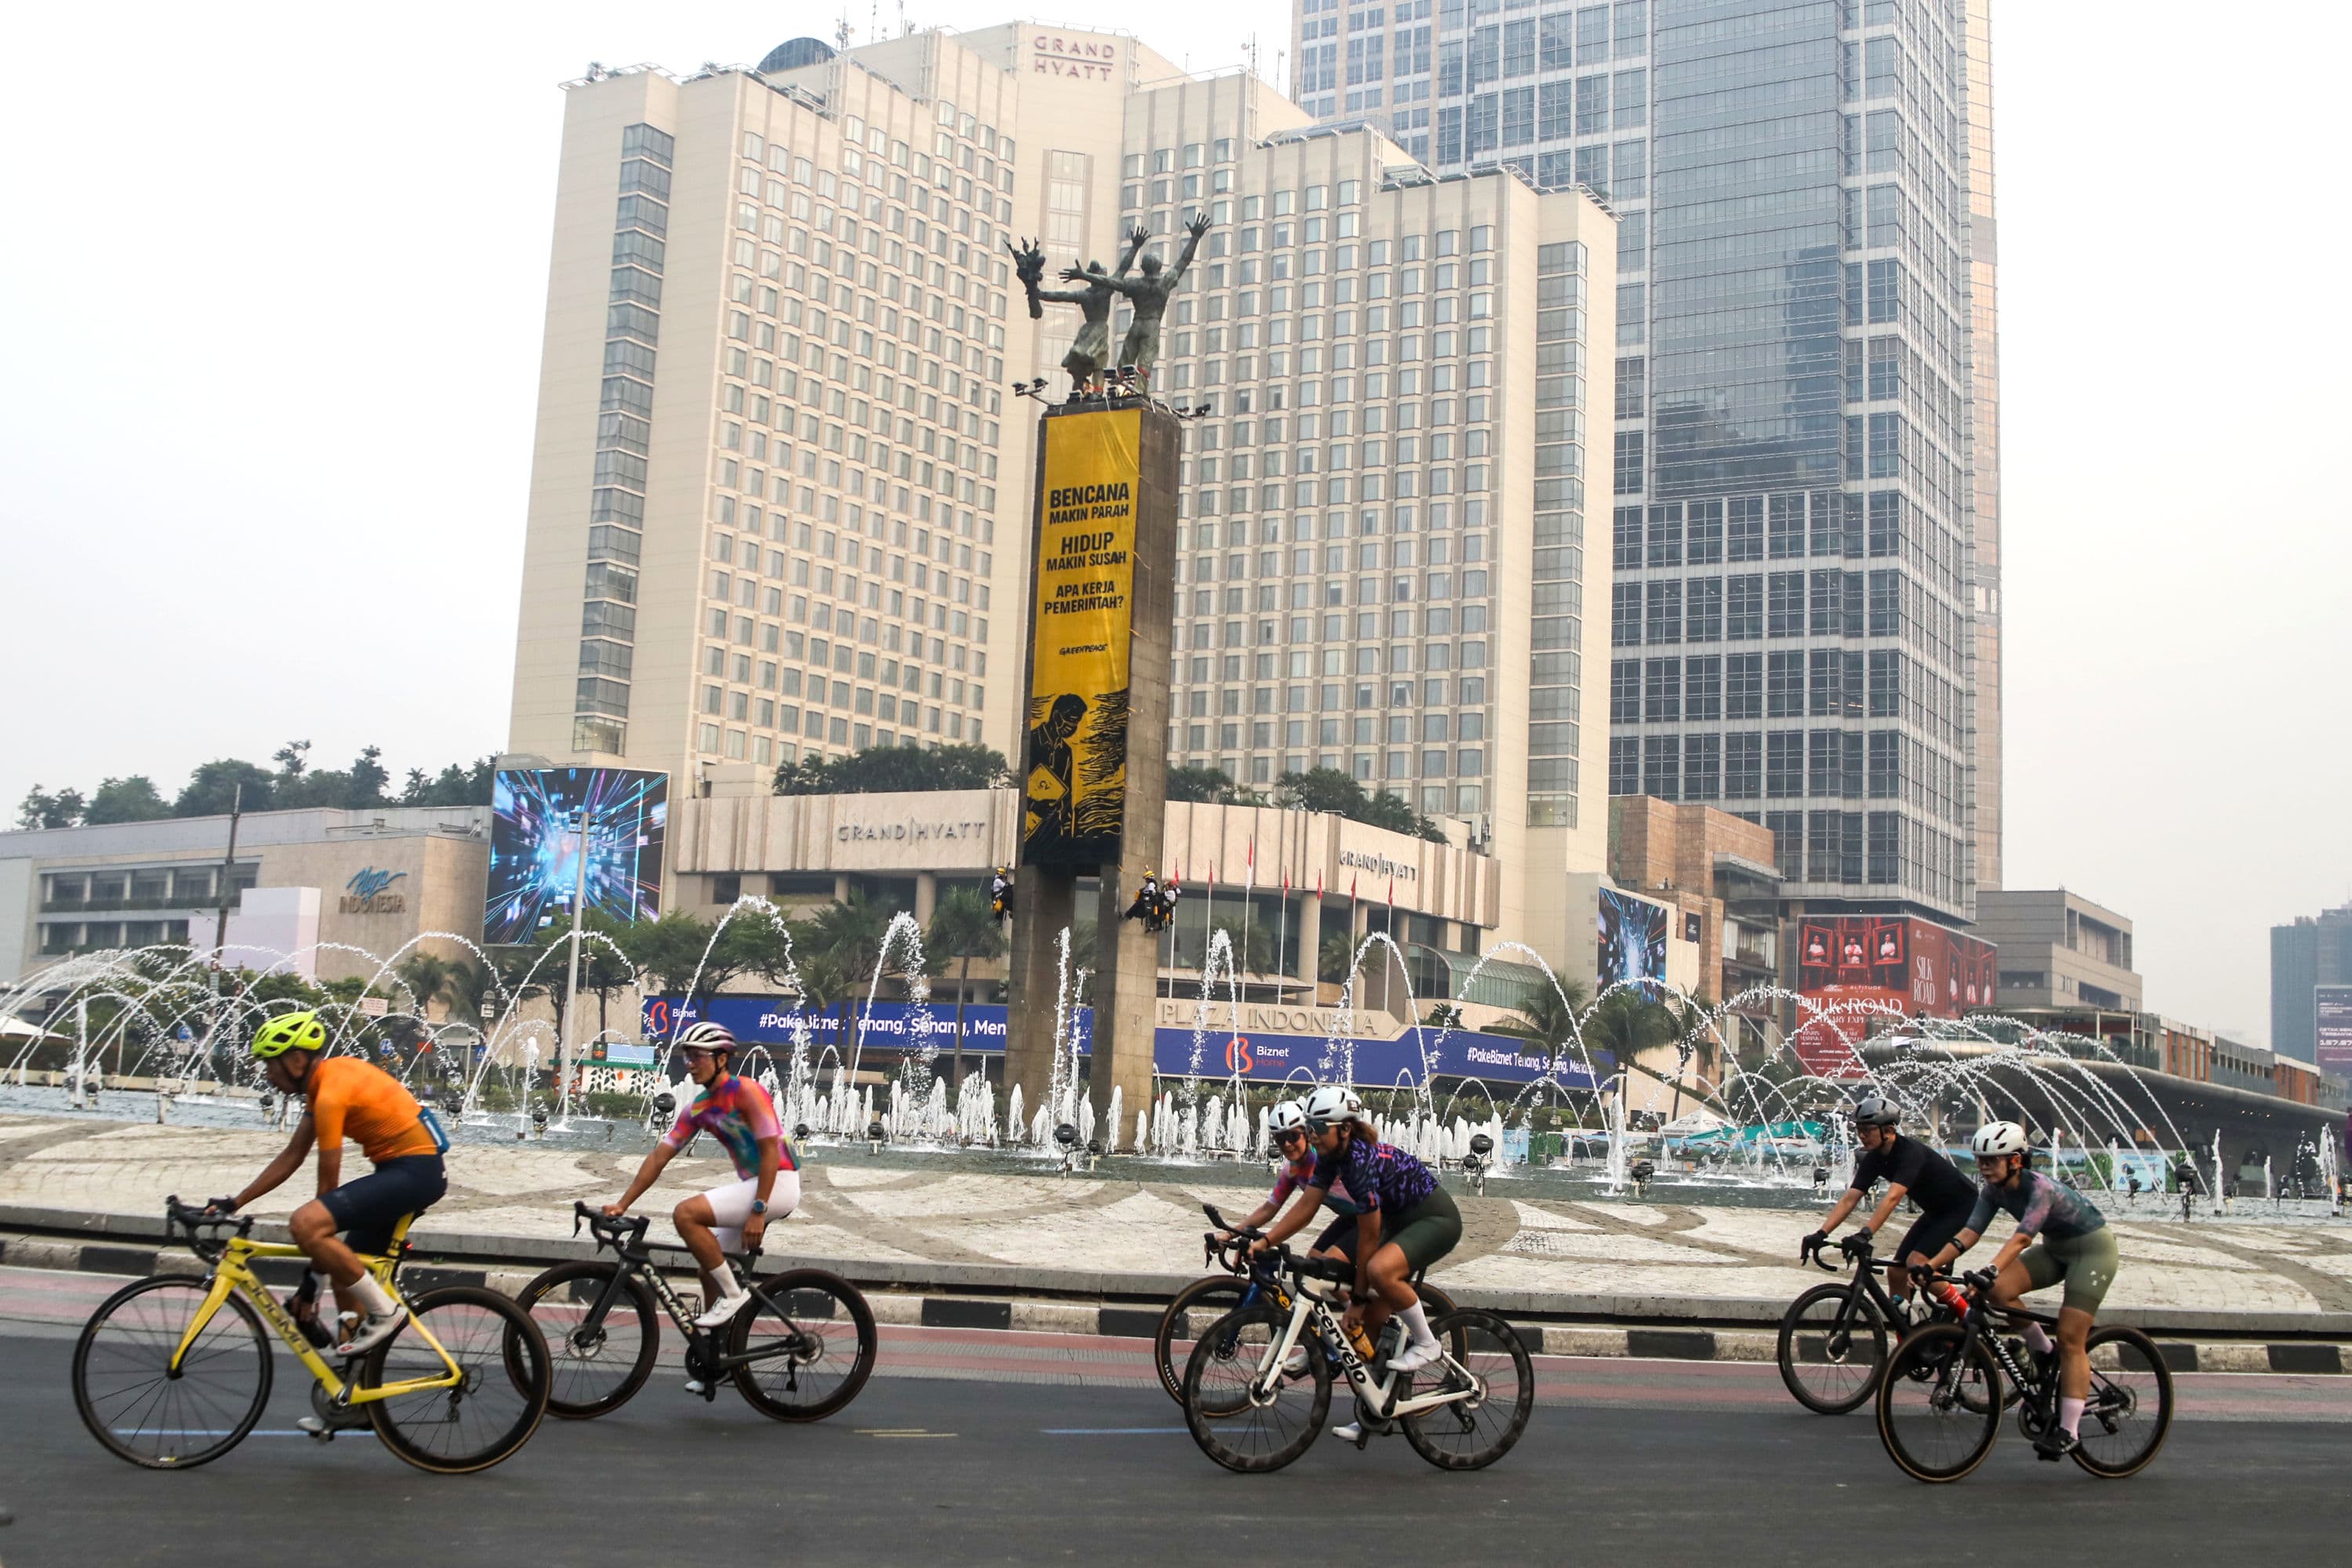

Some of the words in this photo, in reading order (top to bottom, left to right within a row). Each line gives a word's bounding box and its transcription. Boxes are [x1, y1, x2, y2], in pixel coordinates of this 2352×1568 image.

[1034, 36, 1115, 58] GRAND
[1034, 59, 1112, 82] HYATT
[1050, 482, 1129, 508] BENCANA
[1049, 508, 1088, 524] MAKIN
[1091, 504, 1129, 520] PARAH
[1061, 532, 1114, 555] HIDUP
[1047, 555, 1086, 572] MAKIN
[1089, 551, 1127, 566] SUSAH
[1056, 584, 1079, 597] APA
[1082, 580, 1114, 596] KERJA
[1044, 596, 1123, 615] PEMERINTAH?
[1059, 644, 1107, 655] GREENPEACE
[1916, 956, 1933, 981] SILK
[1914, 978, 1936, 1005] ROAD
[672, 1008, 696, 1018] Binet
[1162, 1003, 1240, 1027] PLAZA
[1848, 997, 1903, 1014] ROAD
[848, 1015, 906, 1035] enang,
[1257, 1046, 1290, 1057] Biznet
[1467, 1047, 1512, 1065] #PakeBiznet
[1256, 1058, 1285, 1067] Home
[1985, 1329, 2028, 1392] S-WORKS
